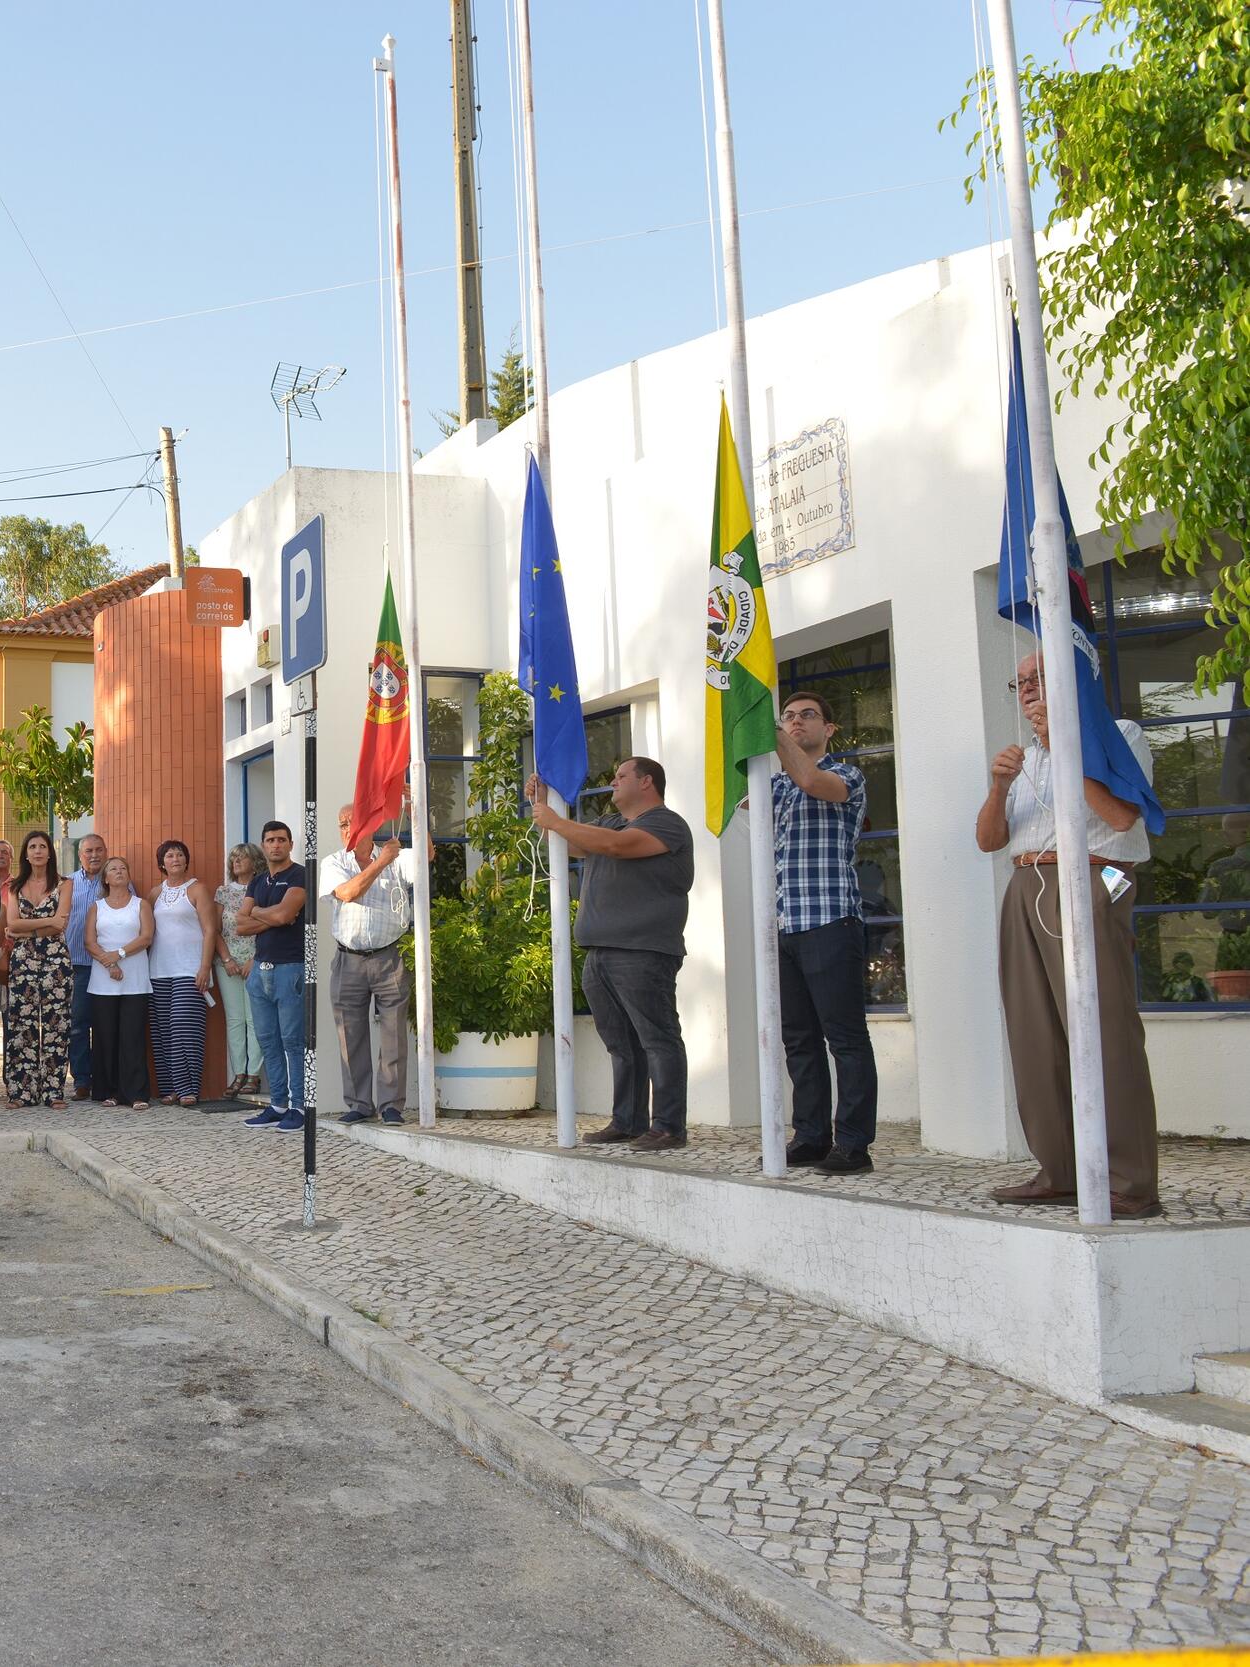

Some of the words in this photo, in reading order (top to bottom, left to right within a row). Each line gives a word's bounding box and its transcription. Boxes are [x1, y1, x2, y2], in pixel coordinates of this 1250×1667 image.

[769, 469, 779, 487] de
[768, 485, 806, 517] ATALAIA
[771, 523, 785, 537] em
[785, 517, 792, 531] 4
[797, 502, 834, 527] Outubro
[774, 536, 796, 557] 1985
[196, 602, 221, 611] posto
[222, 601, 234, 611] de
[289, 548, 313, 660] P
[196, 612, 234, 621] correios
